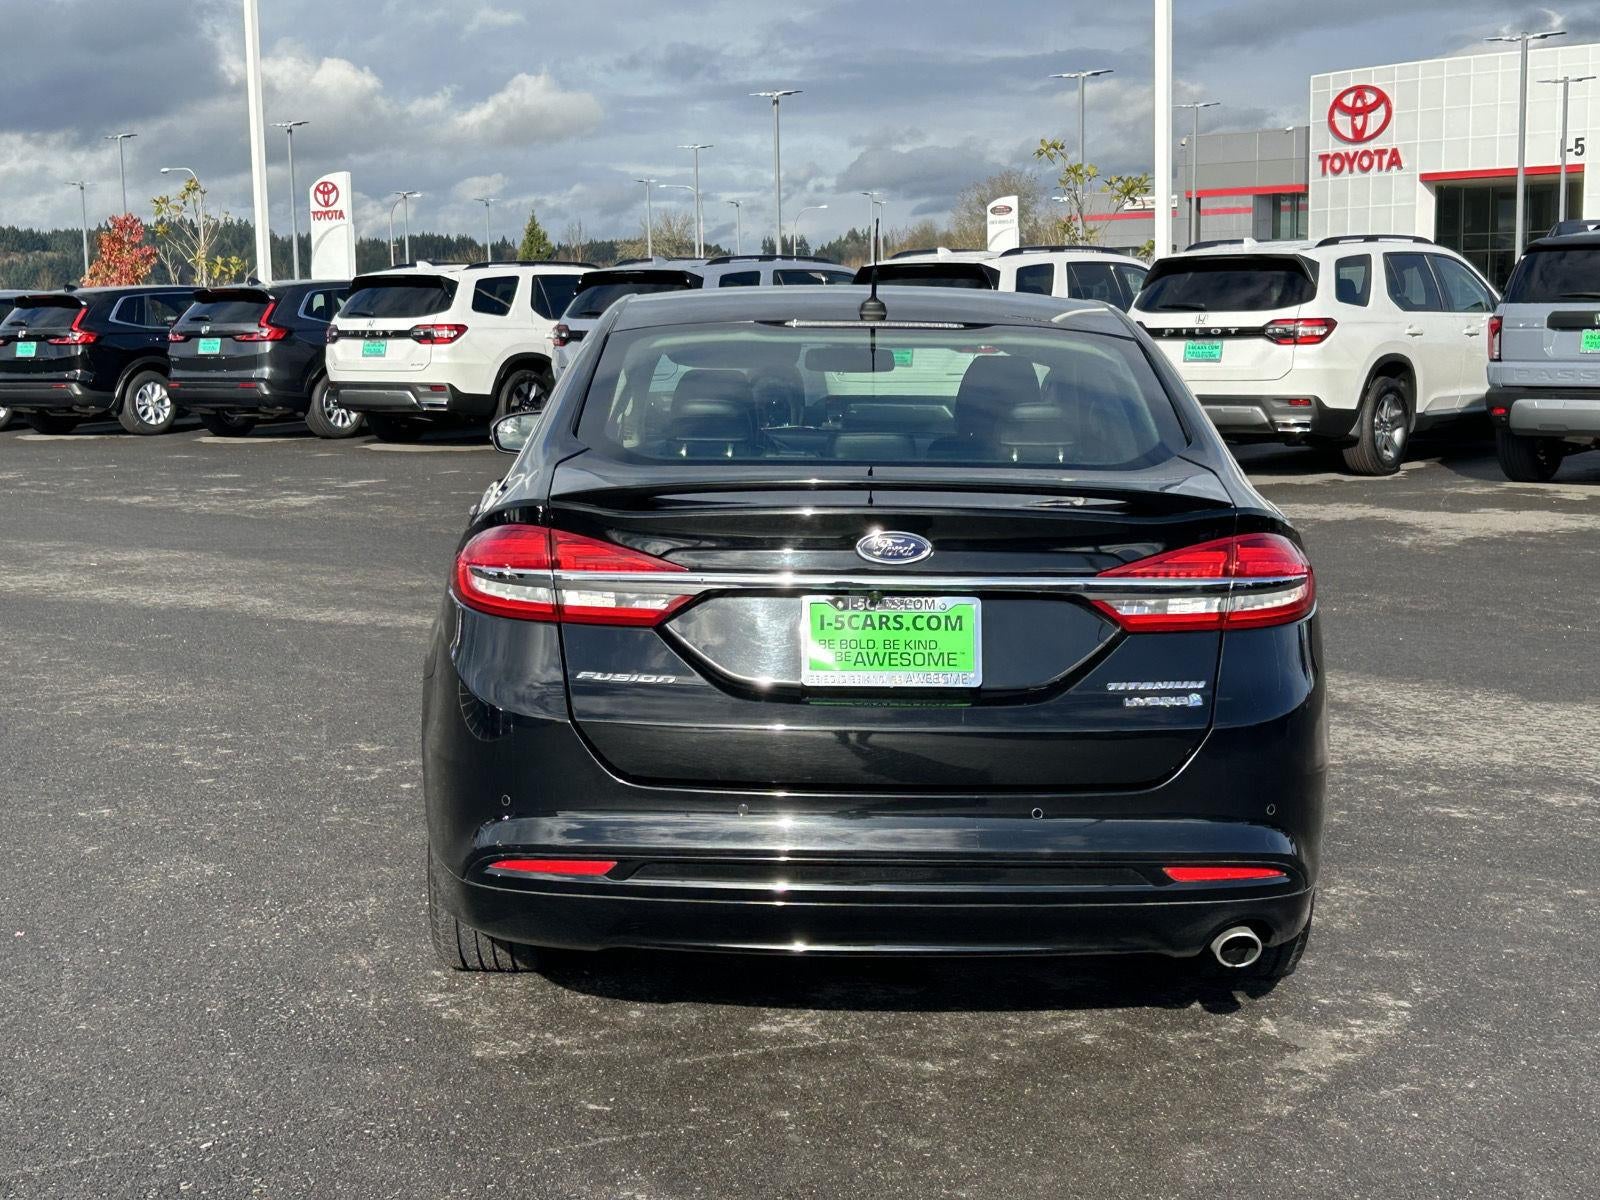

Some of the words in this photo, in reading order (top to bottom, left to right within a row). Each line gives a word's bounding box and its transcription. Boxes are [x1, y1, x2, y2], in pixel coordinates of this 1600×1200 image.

[1318, 147, 1404, 177] TOYOTA
[311, 209, 345, 221] TOYOTA
[1164, 327, 1239, 336] PILOT
[872, 538, 916, 557] Ford
[819, 614, 963, 632] I-5CARS.COM
[818, 639, 835, 650] BE
[883, 639, 900, 650] BE
[834, 651, 852, 662] BE
[853, 651, 958, 667] AWESOME
[576, 671, 677, 683] FUSION
[1106, 681, 1206, 690] TITANIUM
